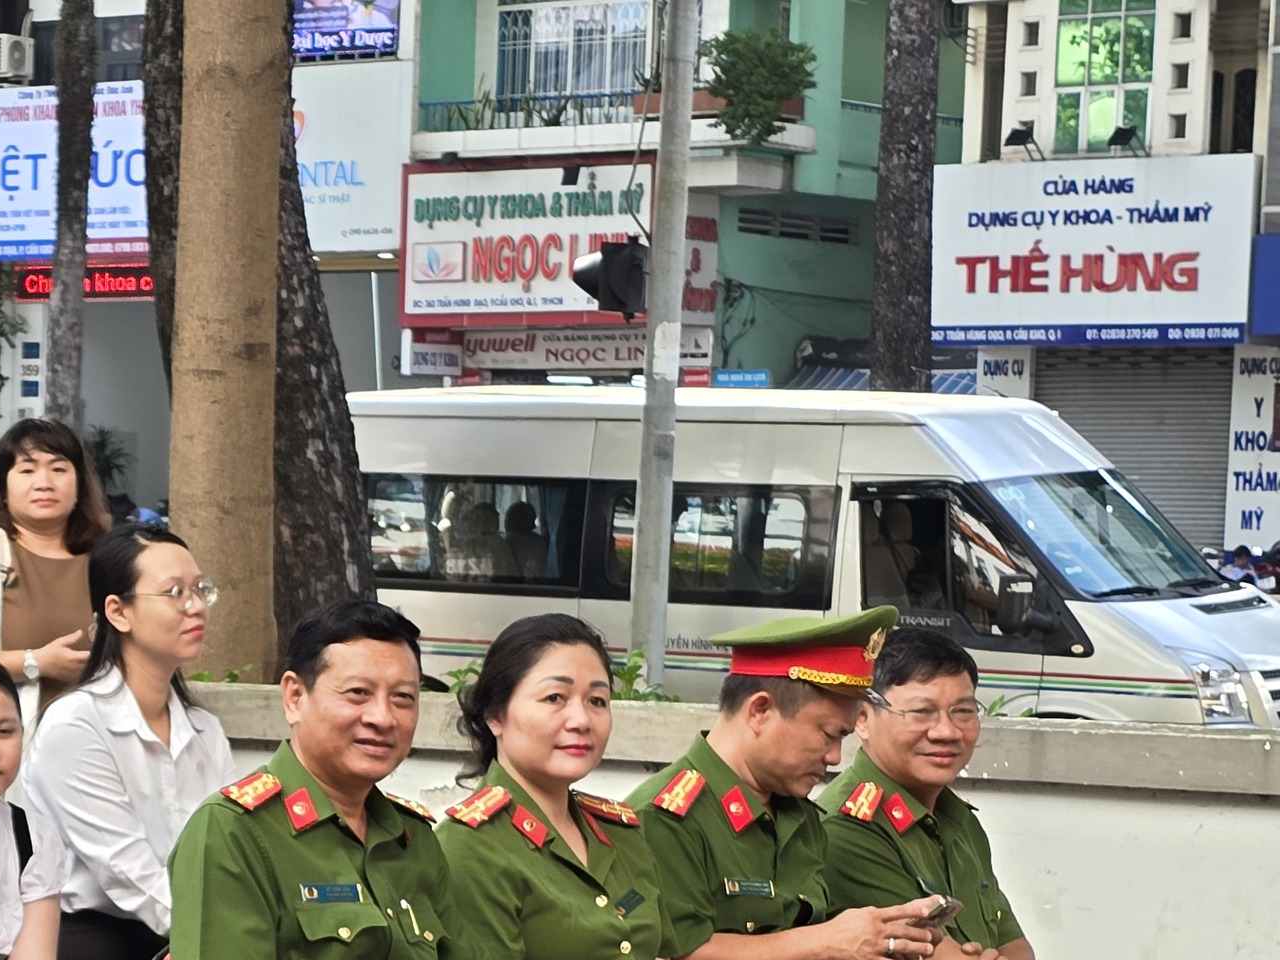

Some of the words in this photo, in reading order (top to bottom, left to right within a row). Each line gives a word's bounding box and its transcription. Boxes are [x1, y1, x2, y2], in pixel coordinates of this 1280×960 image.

[339, 30, 353, 47] Y
[102, 101, 126, 117] KHOA
[90, 140, 145, 187] ỨC
[298, 159, 365, 187] NTAL
[1043, 174, 1079, 196] CỬA
[1084, 175, 1134, 195] HÀNG
[413, 195, 461, 229] DỤNG
[461, 194, 485, 228] CỤ
[487, 194, 497, 220] Y
[499, 191, 547, 220] KHOA
[550, 191, 563, 218] &
[968, 209, 1017, 231] DỤNG
[1022, 210, 1044, 231] CỤ
[1048, 209, 1059, 226] Y
[1063, 208, 1113, 226] KHOA
[471, 232, 563, 293] NGỌC
[955, 239, 1050, 293] THẾ
[1060, 245, 1201, 293] HÙNG
[94, 271, 136, 292] khoa
[464, 333, 536, 358] yuwell
[545, 347, 607, 365] NGỌC
[614, 346, 645, 361] LIN
[21, 364, 39, 376] 359
[983, 358, 1009, 380] DỤNG
[1011, 358, 1024, 380] CỤ
[1239, 356, 1267, 378] DỤNG
[1254, 397, 1264, 418] Y
[1234, 431, 1268, 452] KHO
[899, 615, 952, 628] TRANSIT
[664, 632, 689, 649] UYỀN
